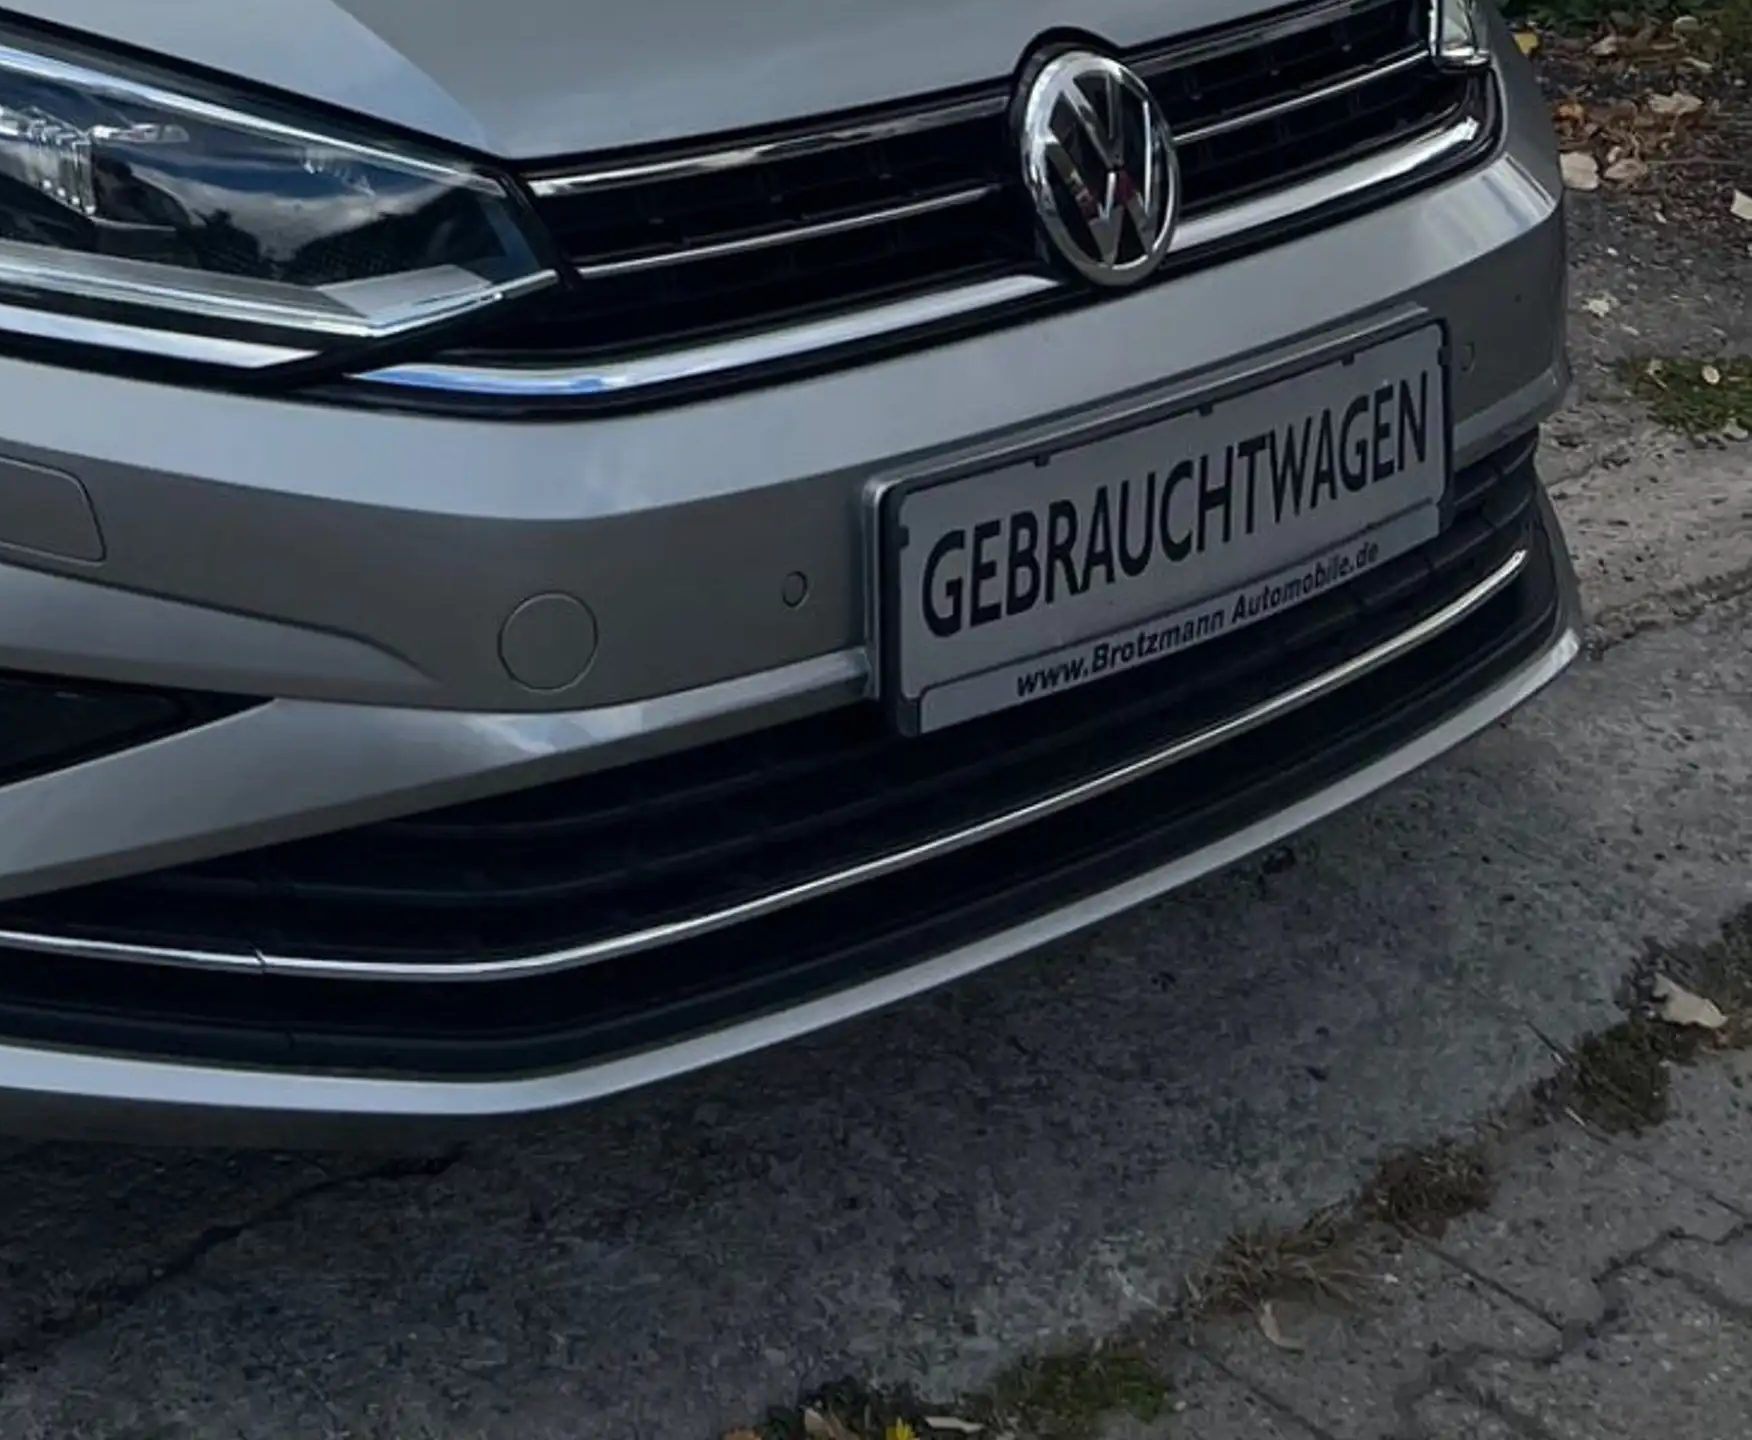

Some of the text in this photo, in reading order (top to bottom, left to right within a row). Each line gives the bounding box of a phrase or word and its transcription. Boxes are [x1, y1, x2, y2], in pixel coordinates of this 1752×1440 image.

[921, 371, 1428, 637] GEBRAUCHTWAGEN
[1016, 542, 1380, 697] www.Brotzmann Automobile.de
